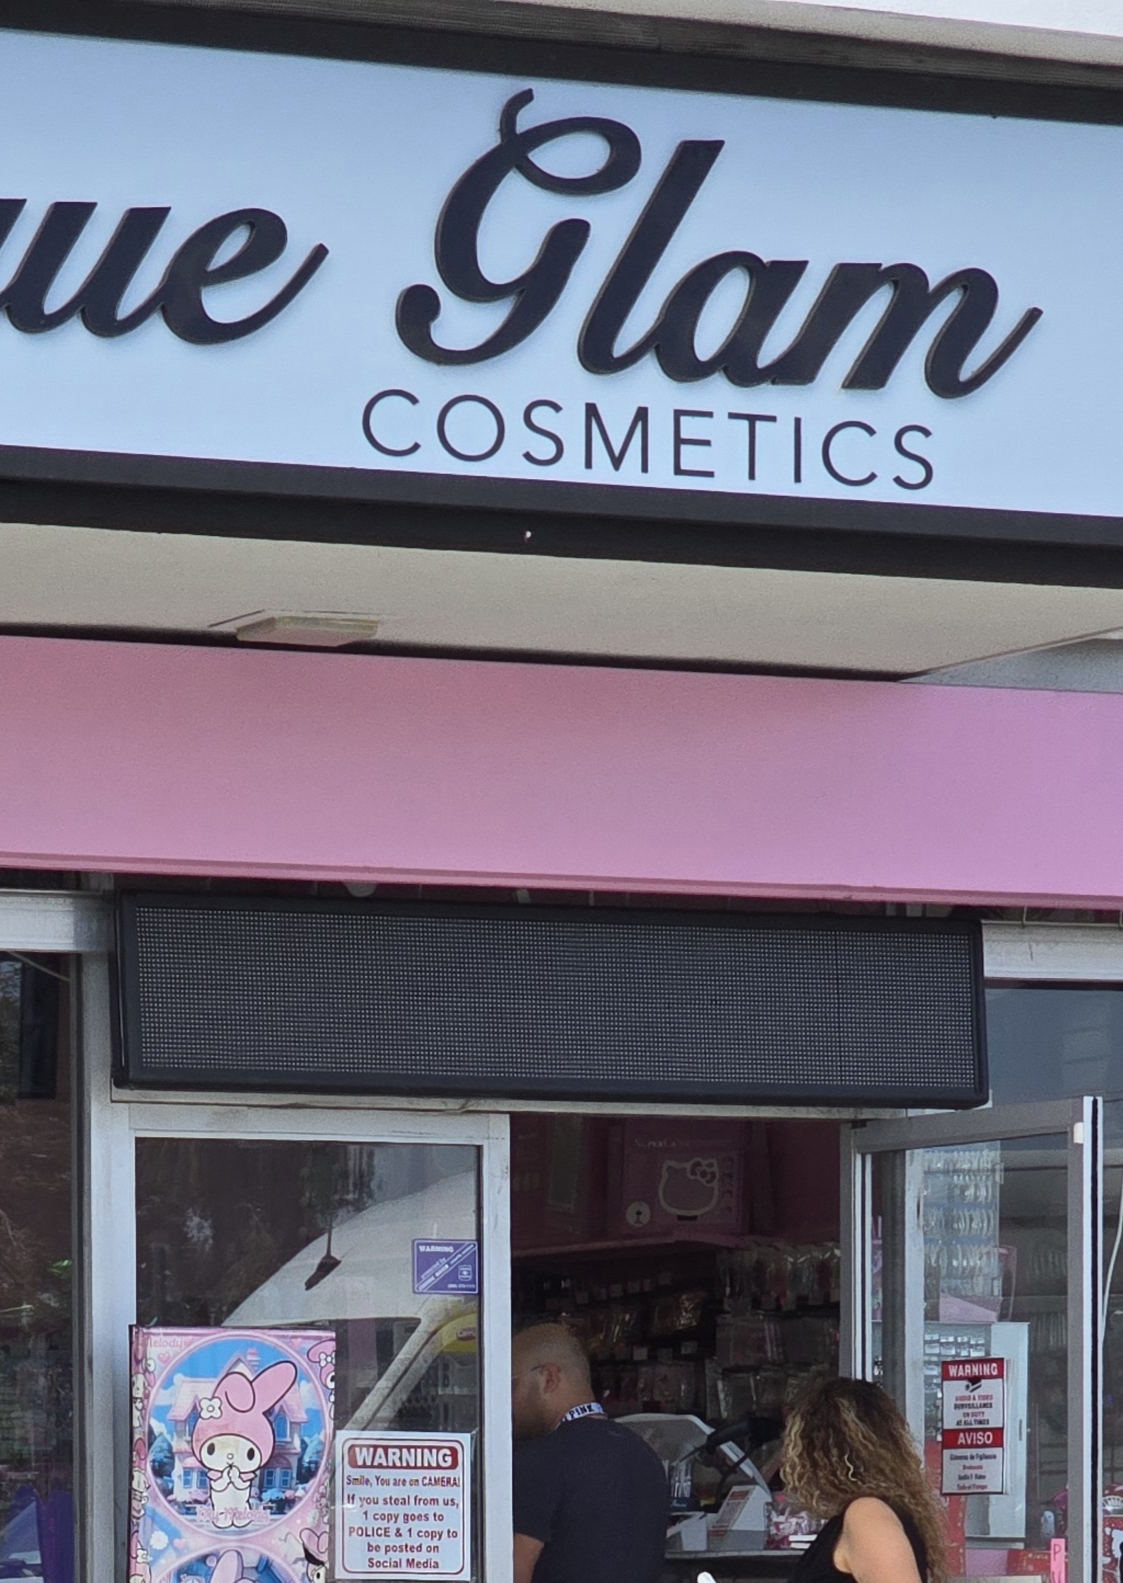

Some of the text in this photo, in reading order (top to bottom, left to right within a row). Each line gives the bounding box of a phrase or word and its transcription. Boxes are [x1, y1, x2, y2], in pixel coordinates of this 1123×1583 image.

[394, 88, 1044, 399] Glam
[361, 388, 935, 491] COSMETICS
[948, 1363, 998, 1377] WARNING
[569, 1404, 594, 1419] PINK
[957, 1432, 993, 1445] AVISO
[354, 1447, 453, 1467] WARNING
[346, 1475, 460, 1488] Smile, You are on CAMERA!
[347, 1494, 459, 1509] If you steal from us,
[363, 1510, 444, 1524] 1 copy goes to
[349, 1527, 458, 1541] POLICE & 1 copy to
[367, 1542, 439, 1555] be posted on
[368, 1558, 439, 1569] Social Media
